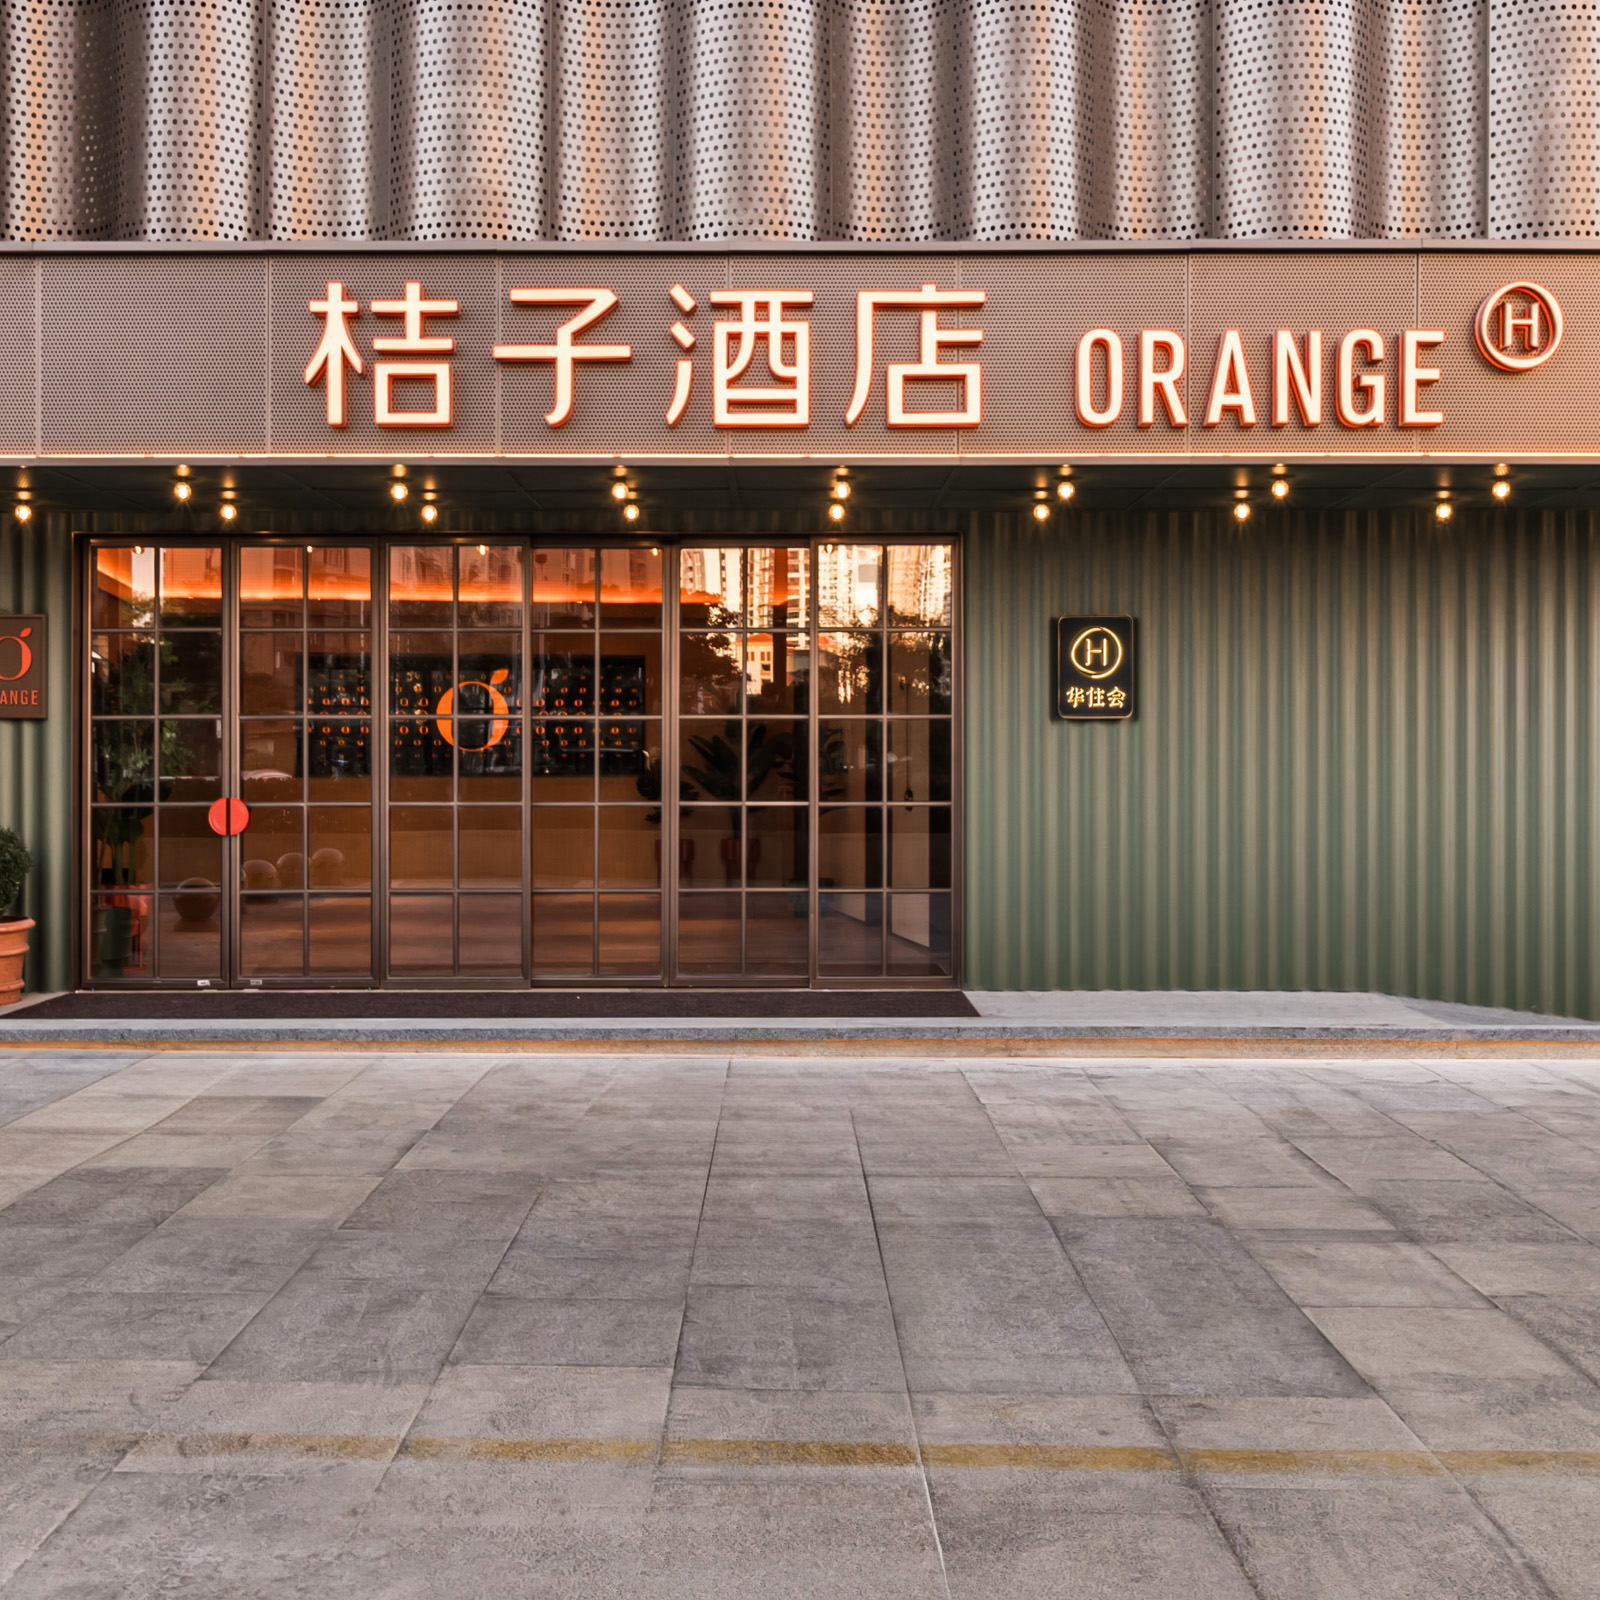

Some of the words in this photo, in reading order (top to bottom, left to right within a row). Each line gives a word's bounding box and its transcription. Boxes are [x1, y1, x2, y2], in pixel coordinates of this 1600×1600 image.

[303, 281, 987, 429] 桔子酒店
[1075, 328, 1445, 429] ORANGE
[1066, 685, 1127, 709] 华住会
